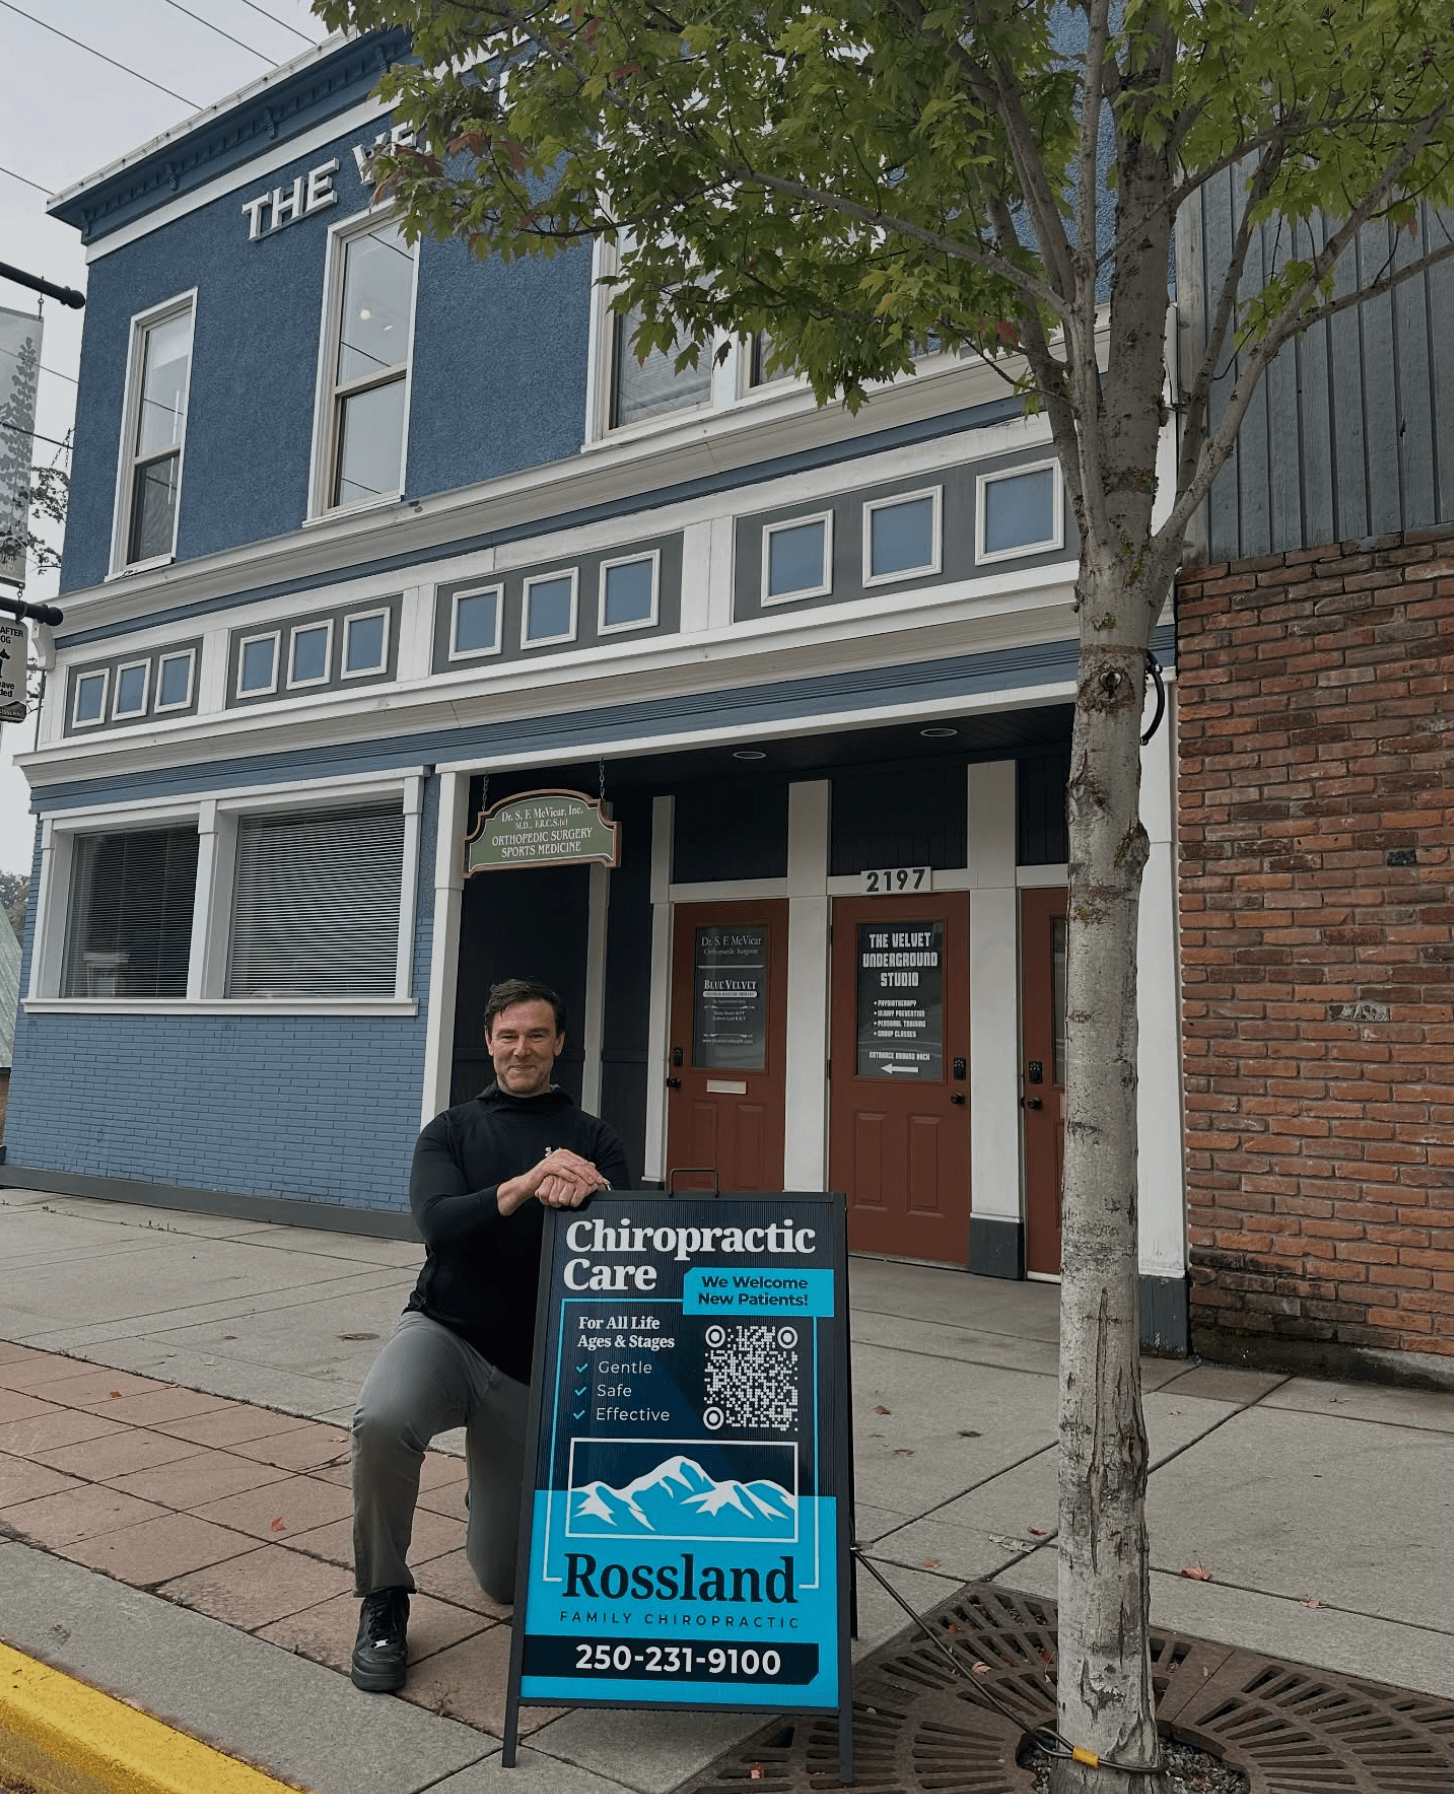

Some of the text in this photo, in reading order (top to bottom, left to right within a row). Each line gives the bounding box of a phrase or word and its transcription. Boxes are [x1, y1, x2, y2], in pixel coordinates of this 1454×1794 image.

[242, 156, 340, 242] THE
[0, 626, 23, 637] AFTER
[501, 811, 513, 822] Dr.
[515, 810, 523, 821] S.
[525, 809, 532, 820] F.
[568, 804, 584, 815] Inc.
[492, 827, 593, 846] ORTHOPEDIC SURGERY
[501, 841, 582, 858] SPORTS MEDICINE
[866, 869, 925, 893] 2197
[701, 936, 713, 947] Dr.
[731, 935, 762, 946] McVicar
[869, 931, 931, 949] THE VELVET
[862, 952, 939, 968] UNDERGROUND
[880, 972, 919, 987] STUDIO
[869, 1051, 895, 1059] ENTRANCE
[895, 1052, 916, 1060] AROUND
[566, 1217, 816, 1262] Chiropractic
[563, 1258, 657, 1291] Care
[701, 1275, 809, 1290] We Welcome
[698, 1292, 809, 1307] New Patients!
[578, 1316, 660, 1330] For All Life
[577, 1335, 676, 1351] Ages & Stages
[598, 1361, 653, 1375] Gentle
[596, 1384, 632, 1398] Safe
[595, 1407, 670, 1422] Effective
[562, 1553, 799, 1604] Rossland
[559, 1610, 799, 1629] FAMILY CHIROPRACTIC
[575, 1643, 782, 1676] 250-231-9100
